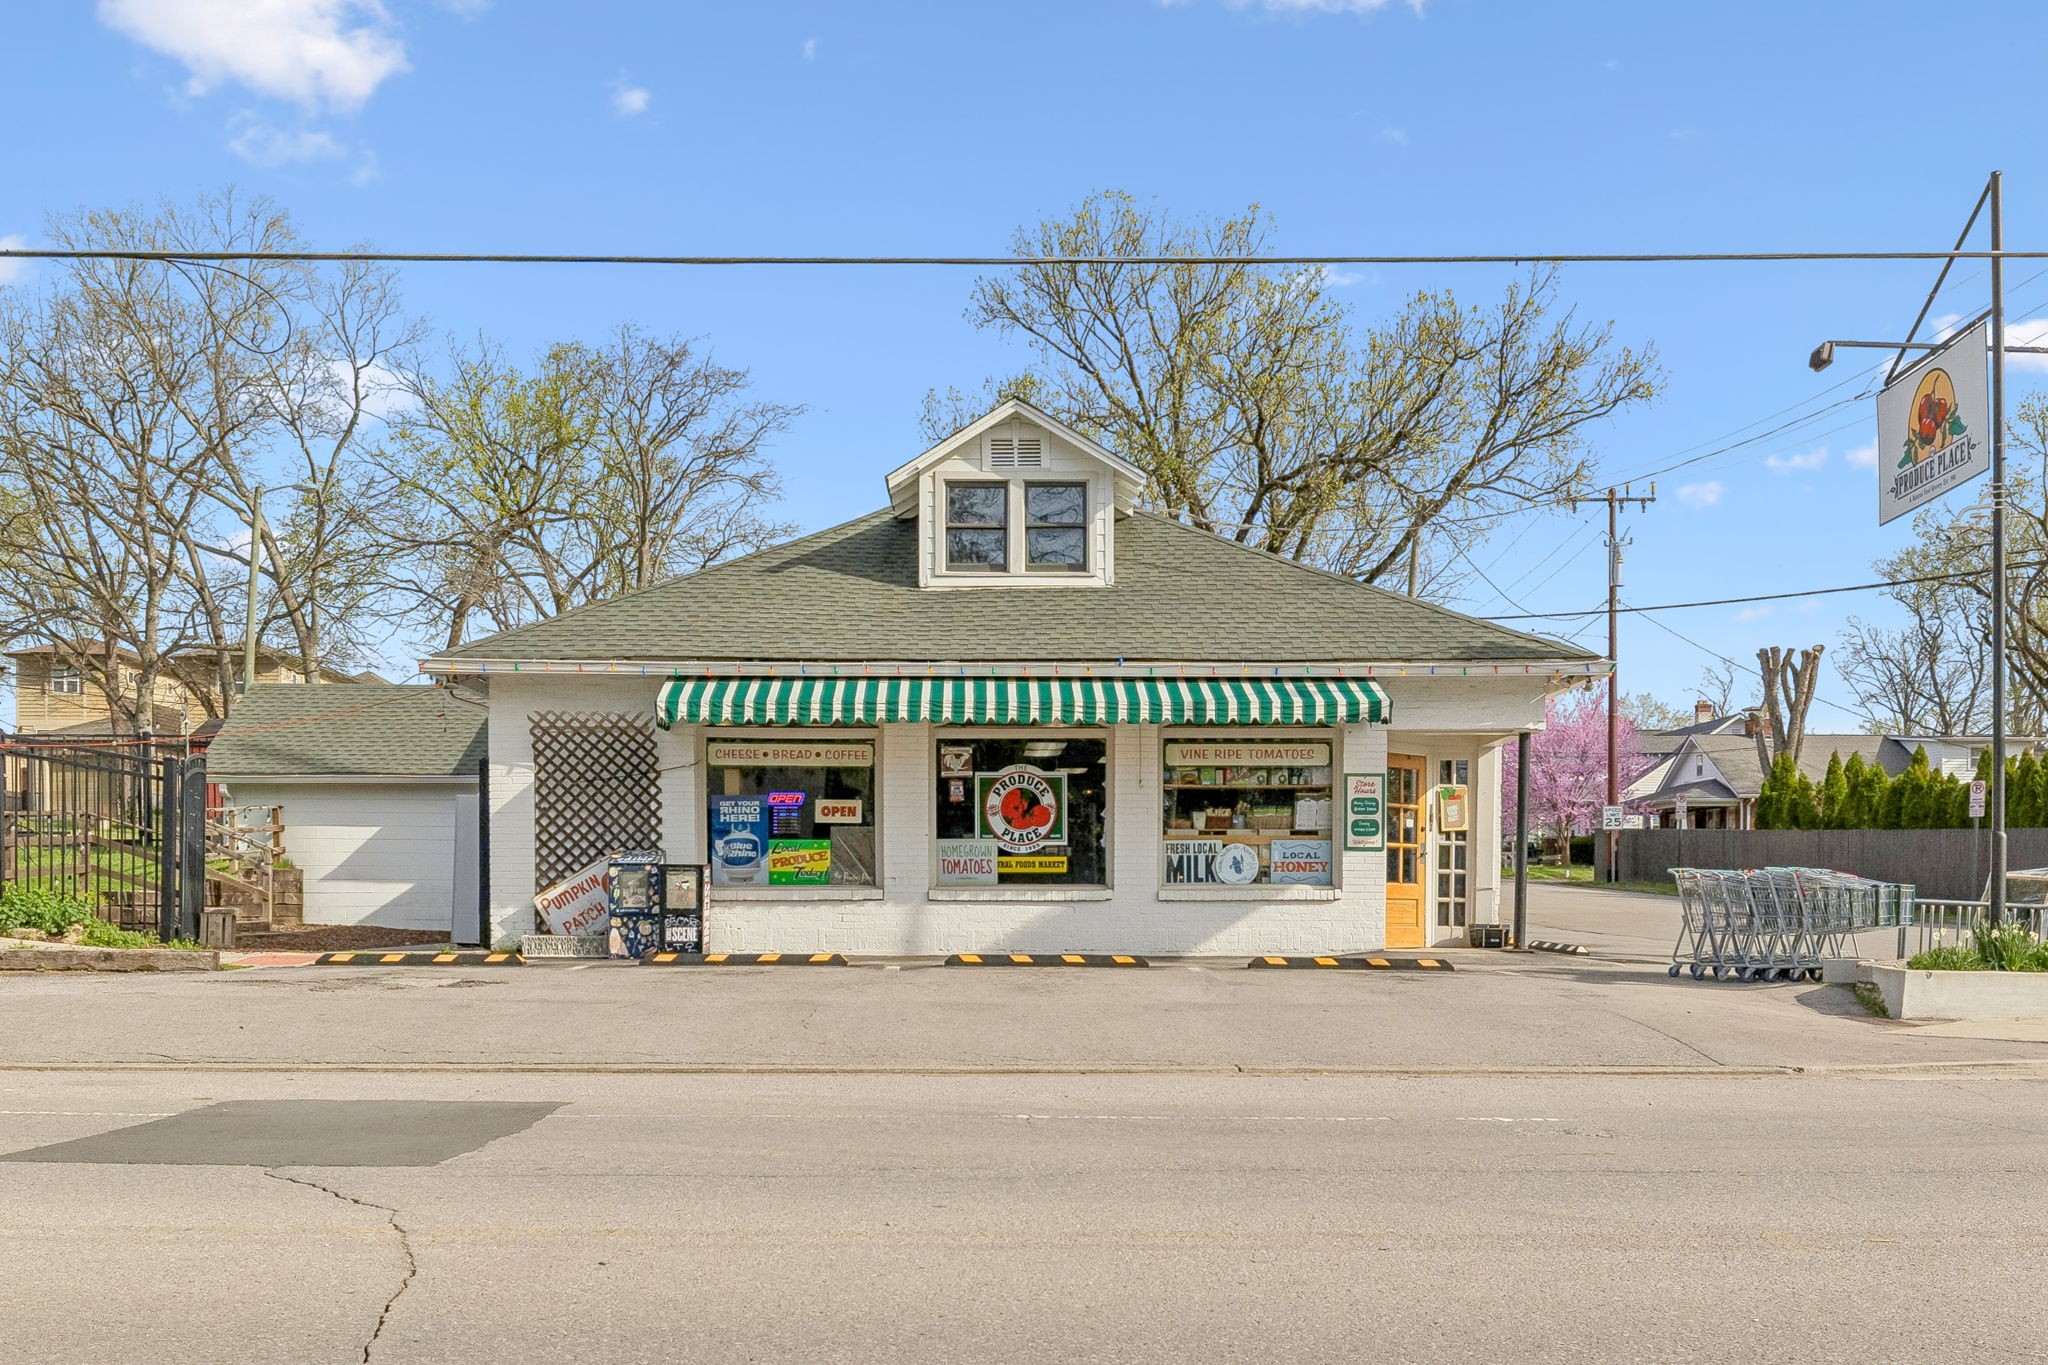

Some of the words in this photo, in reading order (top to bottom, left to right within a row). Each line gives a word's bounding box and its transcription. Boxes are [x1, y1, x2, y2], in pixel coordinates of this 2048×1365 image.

[1899, 463, 1935, 494] PRODUCE
[1937, 441, 1966, 475] PLACE
[715, 748, 759, 760] CHEESE
[772, 748, 812, 760] BREAD
[825, 749, 868, 760] COFFEE
[1181, 748, 1208, 760] VINE
[1214, 748, 1242, 760] RIPE
[1249, 748, 1315, 760] TOMATOES
[992, 774, 1050, 797] PRODUCE
[1353, 786, 1376, 794] Hours
[769, 794, 802, 803] OPEN
[720, 806, 760, 814] RHINO
[821, 806, 857, 817] OPEN
[720, 814, 760, 822] HERE!
[1605, 817, 1621, 826] 25
[1001, 828, 1042, 843] PLACE
[771, 842, 801, 855] Local
[941, 845, 993, 857] HOMEGROWN
[1003, 843, 1021, 851] SINCE
[1165, 843, 1191, 854] FRESH
[1193, 842, 1218, 854] LOCAL
[772, 851, 828, 868] PRODUCE
[941, 858, 993, 874] TOMATOES
[1165, 855, 1217, 883] MILK
[1273, 861, 1329, 873] HONEY
[792, 867, 829, 880] Today!
[563, 902, 607, 935] PATCH
[672, 927, 698, 942] SCENE
